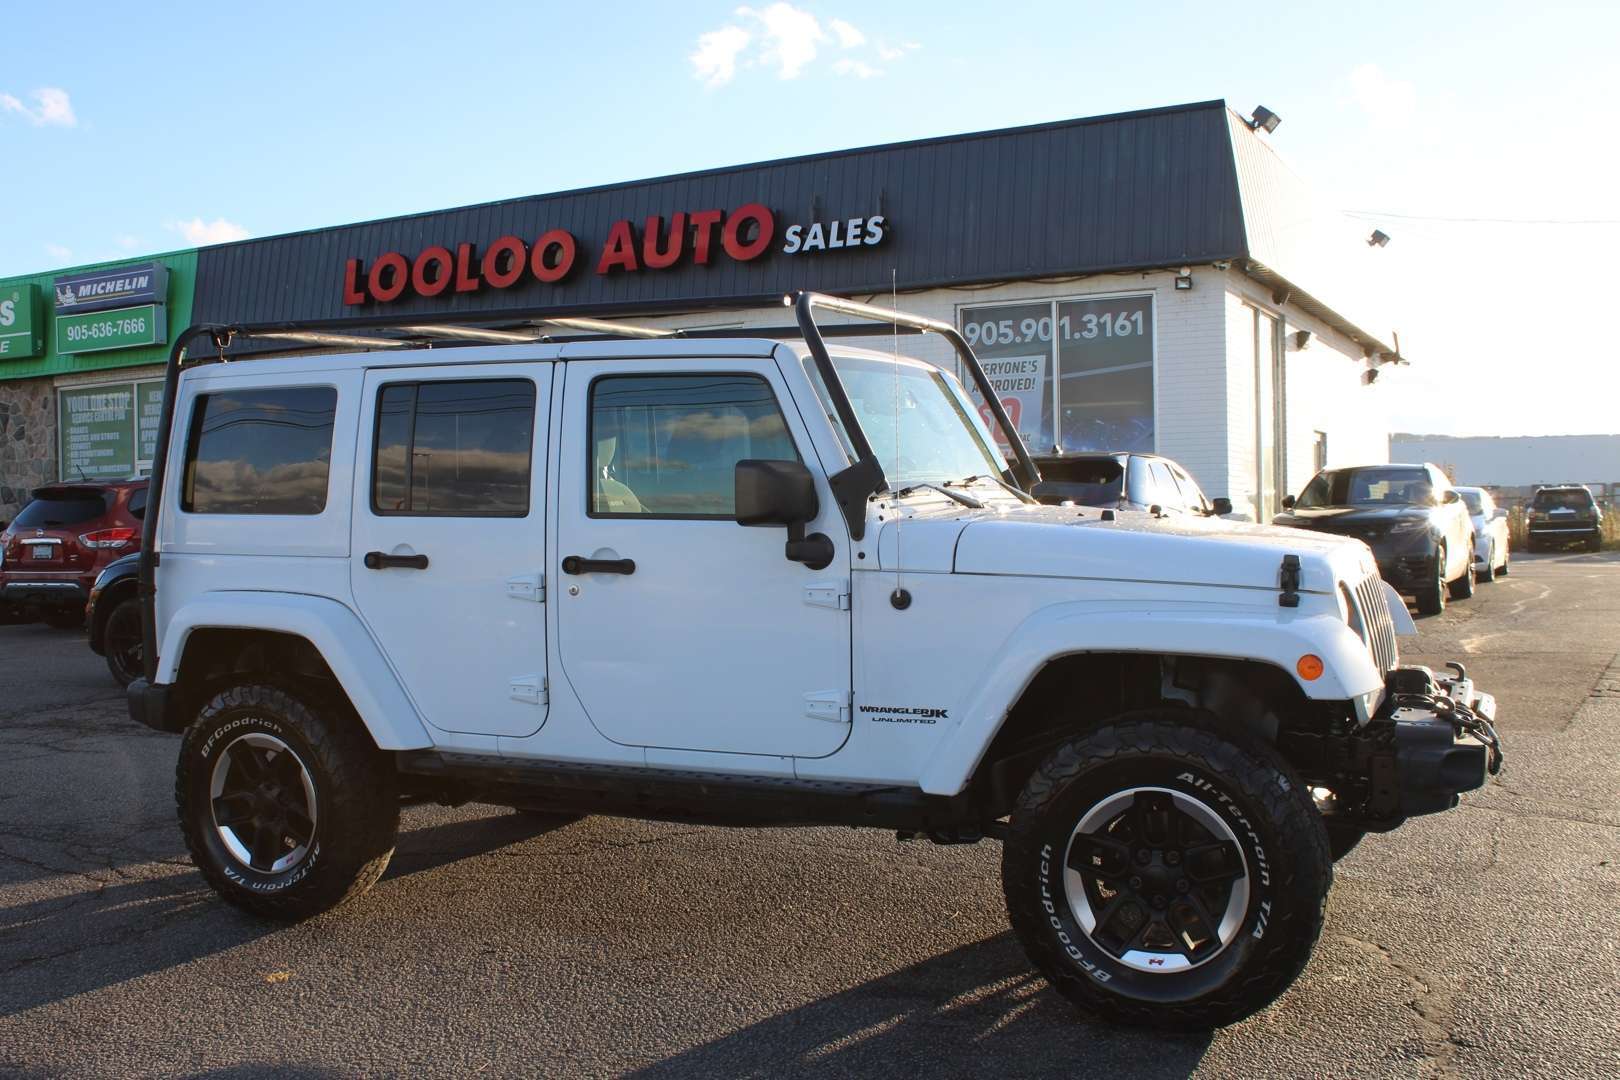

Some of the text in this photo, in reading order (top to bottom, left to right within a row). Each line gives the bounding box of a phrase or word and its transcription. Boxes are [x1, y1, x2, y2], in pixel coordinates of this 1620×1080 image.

[343, 203, 885, 306] LOOLOO AUTO SALES
[78, 276, 148, 297] MICHELIN
[67, 319, 145, 340] 905-636-7666
[964, 310, 1143, 346] 905.901.3161
[970, 360, 1038, 376] ERYONE'S
[201, 717, 283, 757] BFGoodrich
[872, 717, 937, 725] UNLIMITED
[1175, 772, 1272, 940] All-Terrain T/A
[1038, 844, 1113, 983] BFGoodrich
